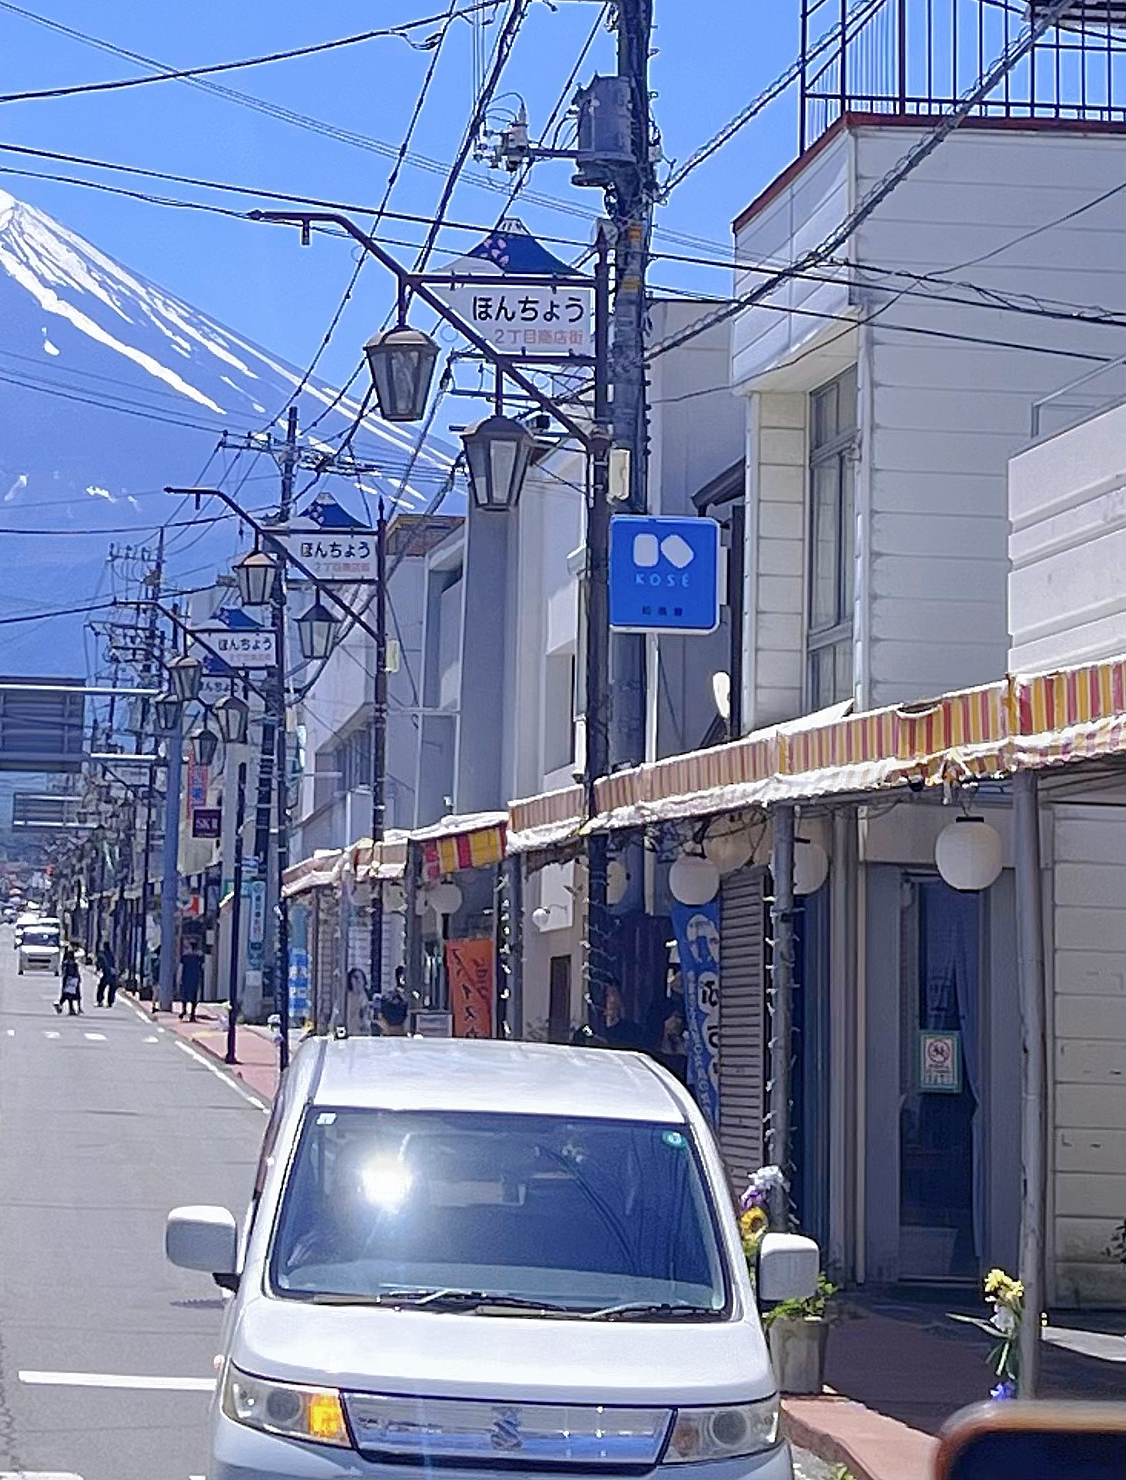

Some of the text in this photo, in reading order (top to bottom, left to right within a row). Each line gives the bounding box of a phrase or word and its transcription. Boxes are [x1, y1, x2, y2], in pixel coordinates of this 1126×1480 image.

[473, 295, 585, 323] ほんちょう
[301, 541, 370, 559] ほんちょう
[218, 637, 273, 651] ほんちょう
